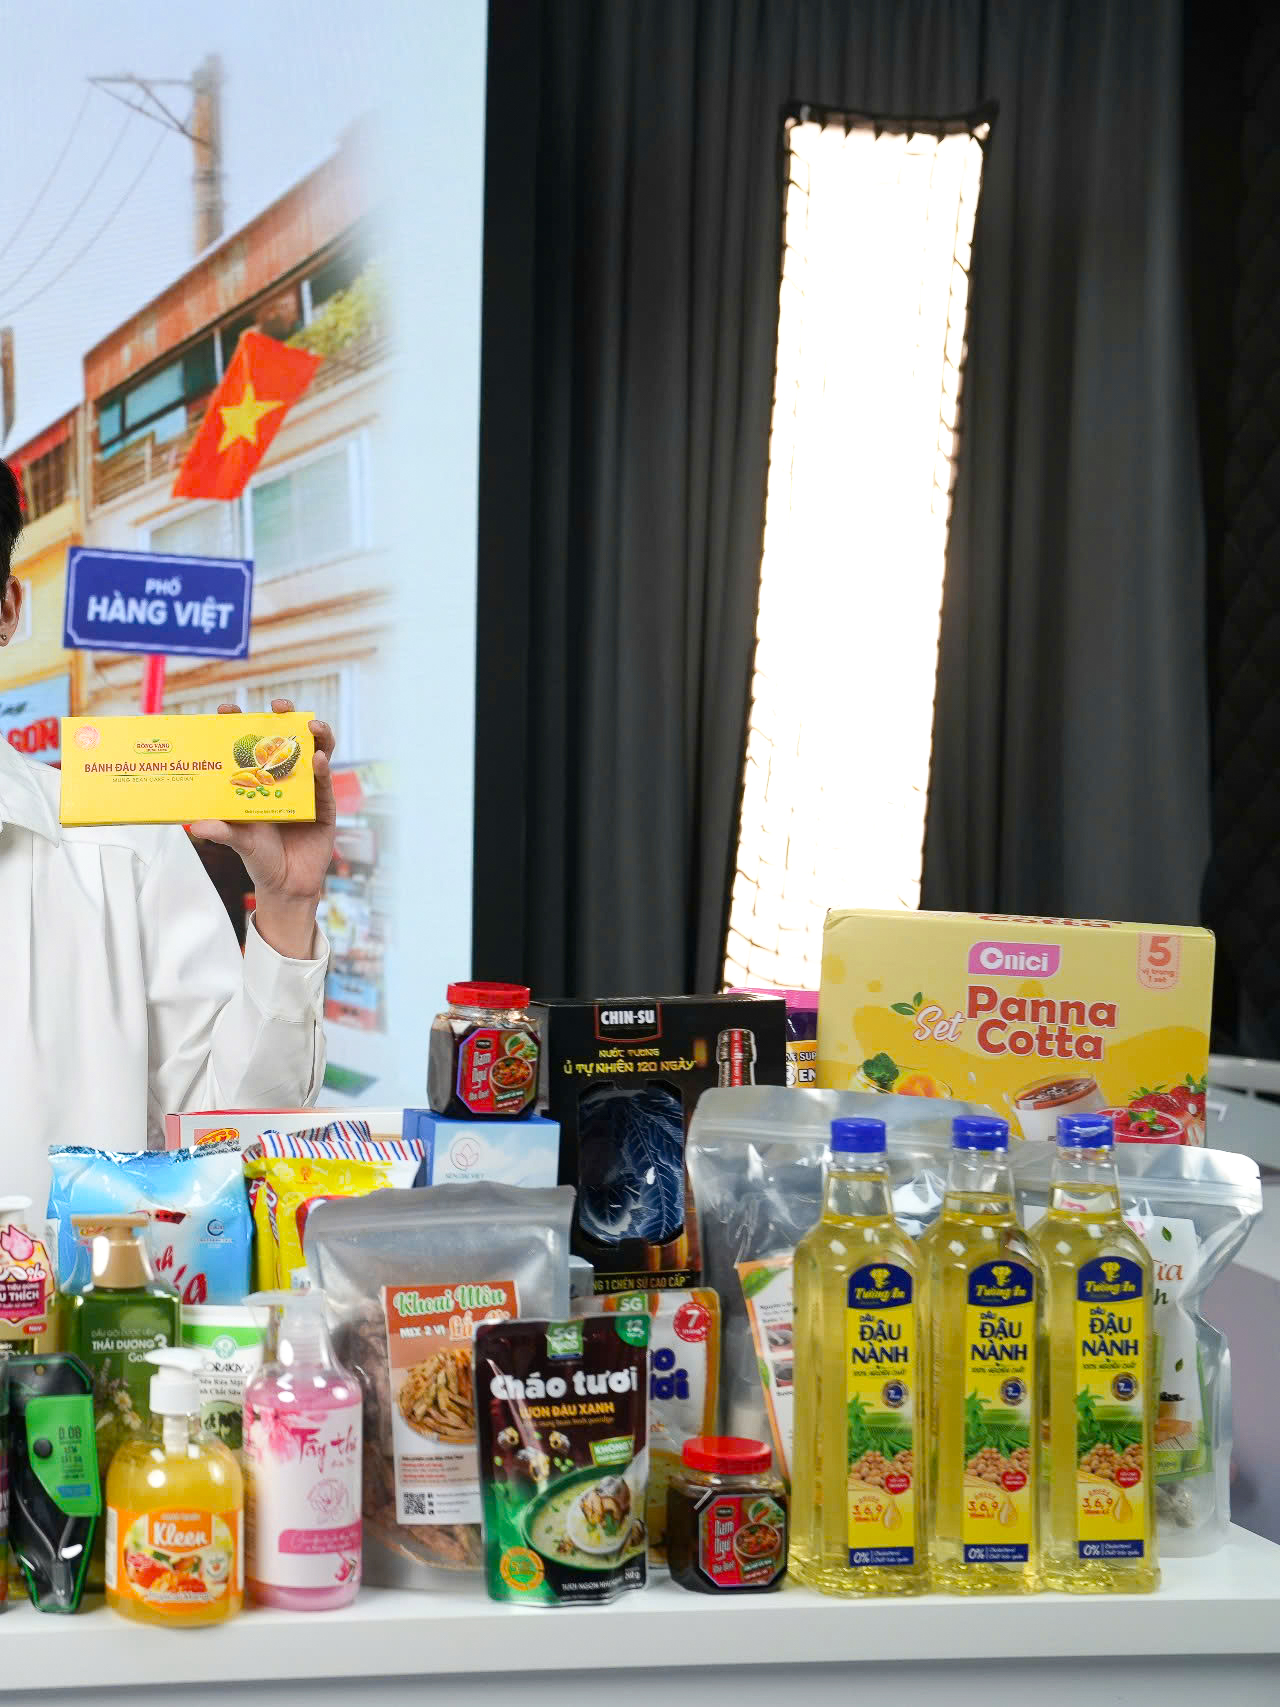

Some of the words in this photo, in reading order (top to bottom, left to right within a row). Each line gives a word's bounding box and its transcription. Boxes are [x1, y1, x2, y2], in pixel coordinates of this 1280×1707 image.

[145, 576, 181, 597] PHỐ
[87, 591, 167, 626] HÀNG
[172, 597, 235, 633] VIỆT
[84, 761, 113, 773] BÁNH
[114, 760, 137, 775] ĐẬU
[138, 762, 168, 772] XANH
[192, 759, 223, 771] RIÊNG
[1148, 936, 1172, 967] 5
[600, 1010, 655, 1025] CHIN-SU
[967, 985, 1118, 1029] Panna
[913, 1006, 966, 1043] Set
[976, 1020, 1104, 1061] Cotta
[595, 1059, 634, 1074] NHIÊN
[637, 1061, 657, 1072] 120
[649, 1277, 667, 1288] CAO
[8, 1289, 40, 1301] THÍCH
[685, 1310, 699, 1328] 7
[979, 1317, 1022, 1341] ĐẬU
[1089, 1312, 1132, 1336] ĐẬU
[858, 1319, 901, 1342] ĐẬU
[92, 1339, 114, 1350] THÁI
[852, 1341, 908, 1364] NÀNH
[971, 1340, 1028, 1361] NÀNH
[1082, 1335, 1139, 1357] NÀNH
[490, 1371, 567, 1400] Cháo
[573, 1365, 638, 1396] tươi
[578, 1402, 616, 1415] XANH
[968, 1548, 985, 1560] 0%
[1083, 1544, 1101, 1556] 0%
